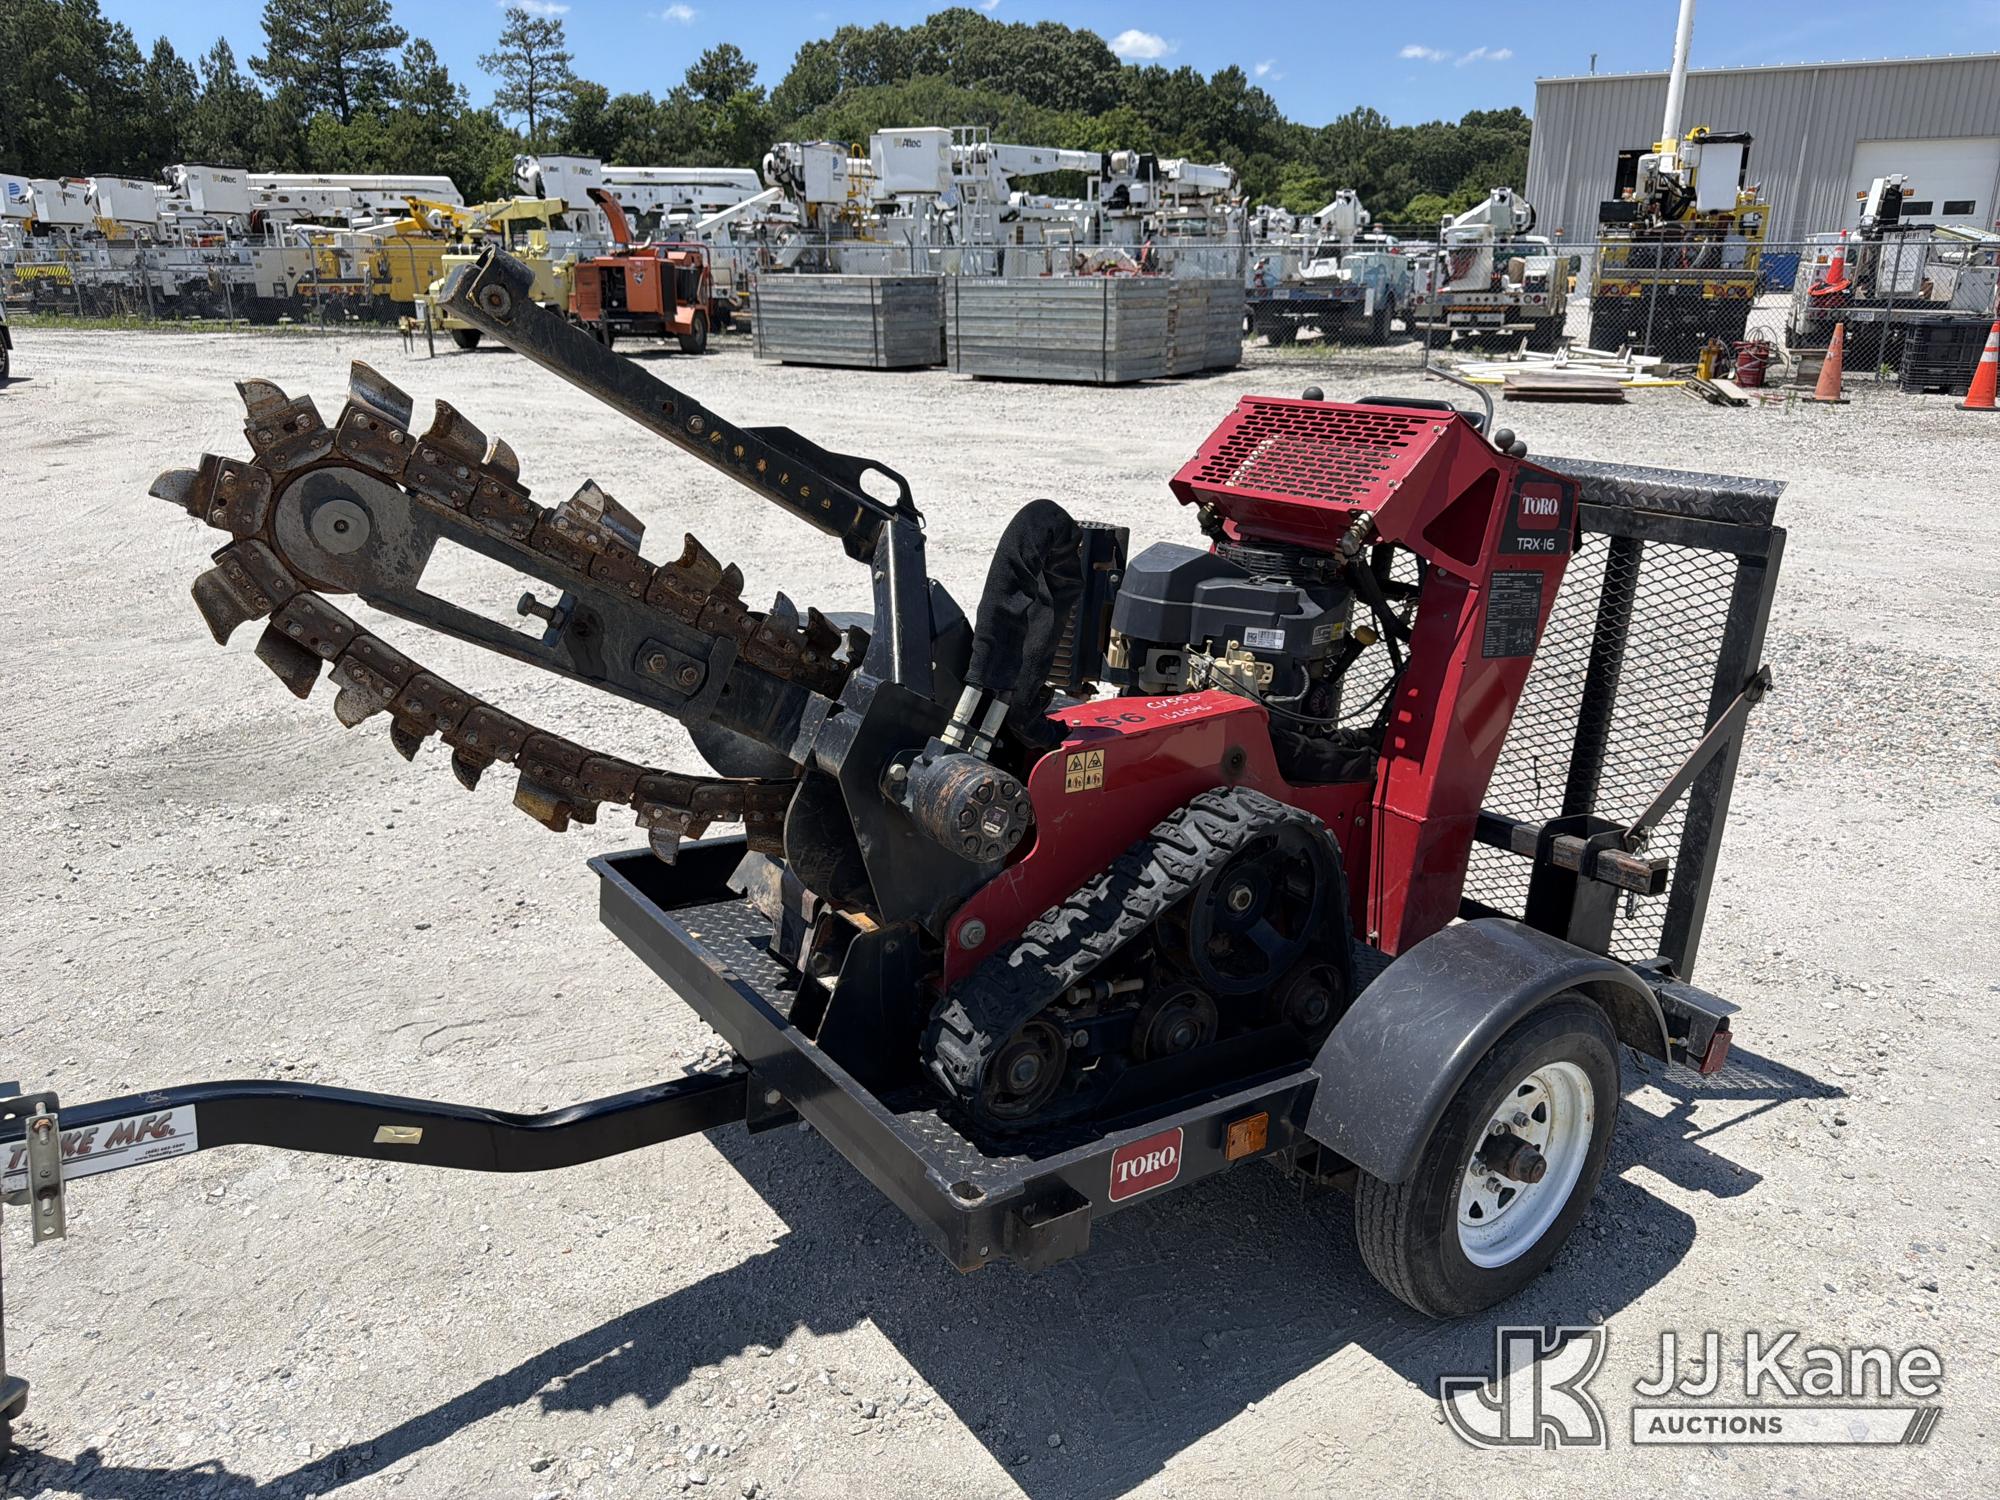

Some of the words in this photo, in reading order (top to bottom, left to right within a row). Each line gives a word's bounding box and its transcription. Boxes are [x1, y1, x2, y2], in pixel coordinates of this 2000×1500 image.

[902, 138, 922, 148] Altec
[221, 174, 237, 184] Altec
[1522, 497, 1559, 515] TORO
[1094, 713, 1147, 727] 56
[7, 1126, 98, 1169] TKE
[104, 1111, 176, 1149] MFG.
[1117, 1146, 1176, 1183] TORO
